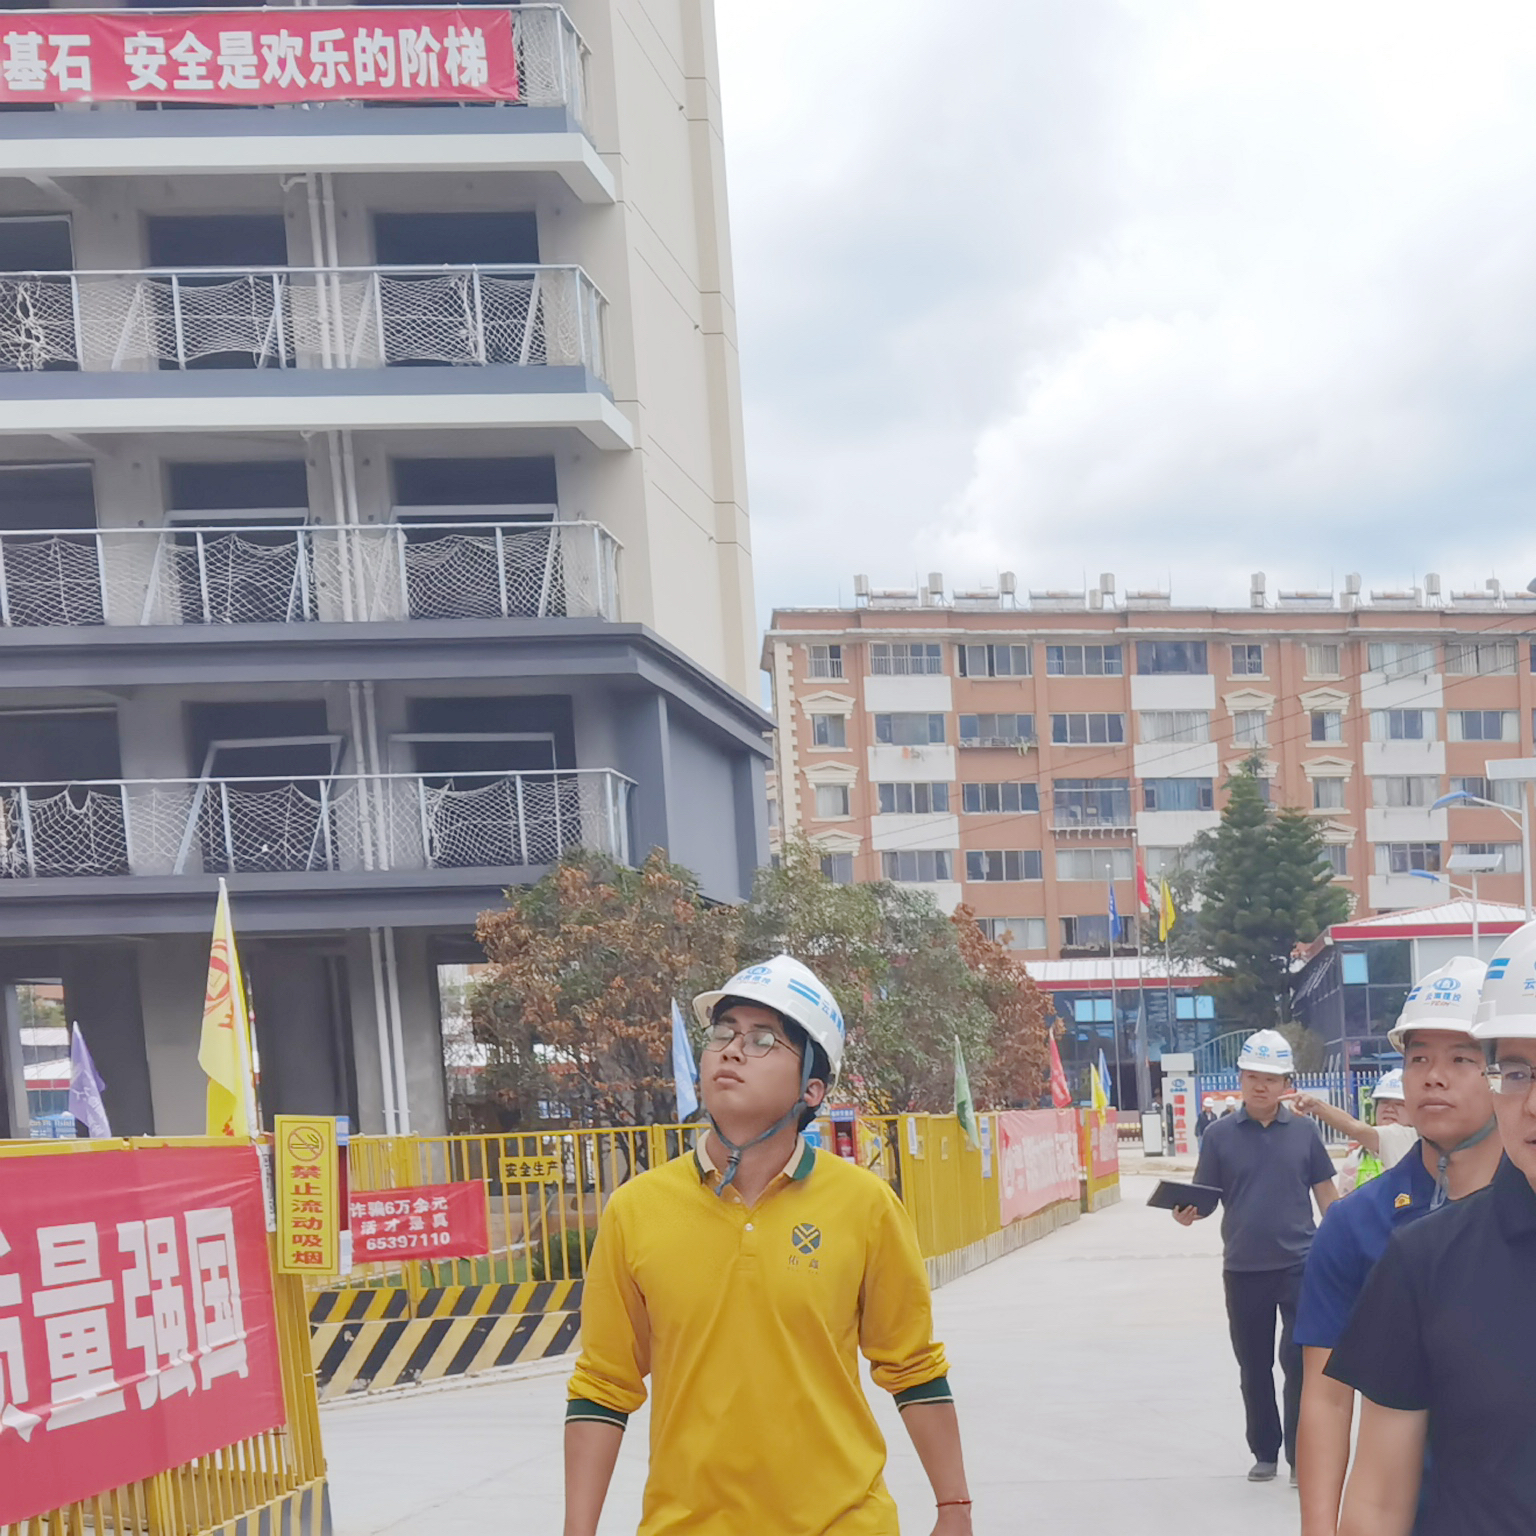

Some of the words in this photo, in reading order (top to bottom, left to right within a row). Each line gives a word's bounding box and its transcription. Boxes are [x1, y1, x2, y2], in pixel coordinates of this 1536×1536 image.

[3, 31, 92, 92] 基石
[123, 26, 489, 92] 安全是欢乐的阶梯
[1425, 991, 1462, 1003] 云南建投
[505, 1160, 559, 1178] 安全生产
[290, 1164, 324, 1265] 禁止流动吸烟
[350, 1196, 449, 1219] 诈骗6万余元
[366, 1231, 451, 1252] 65397110
